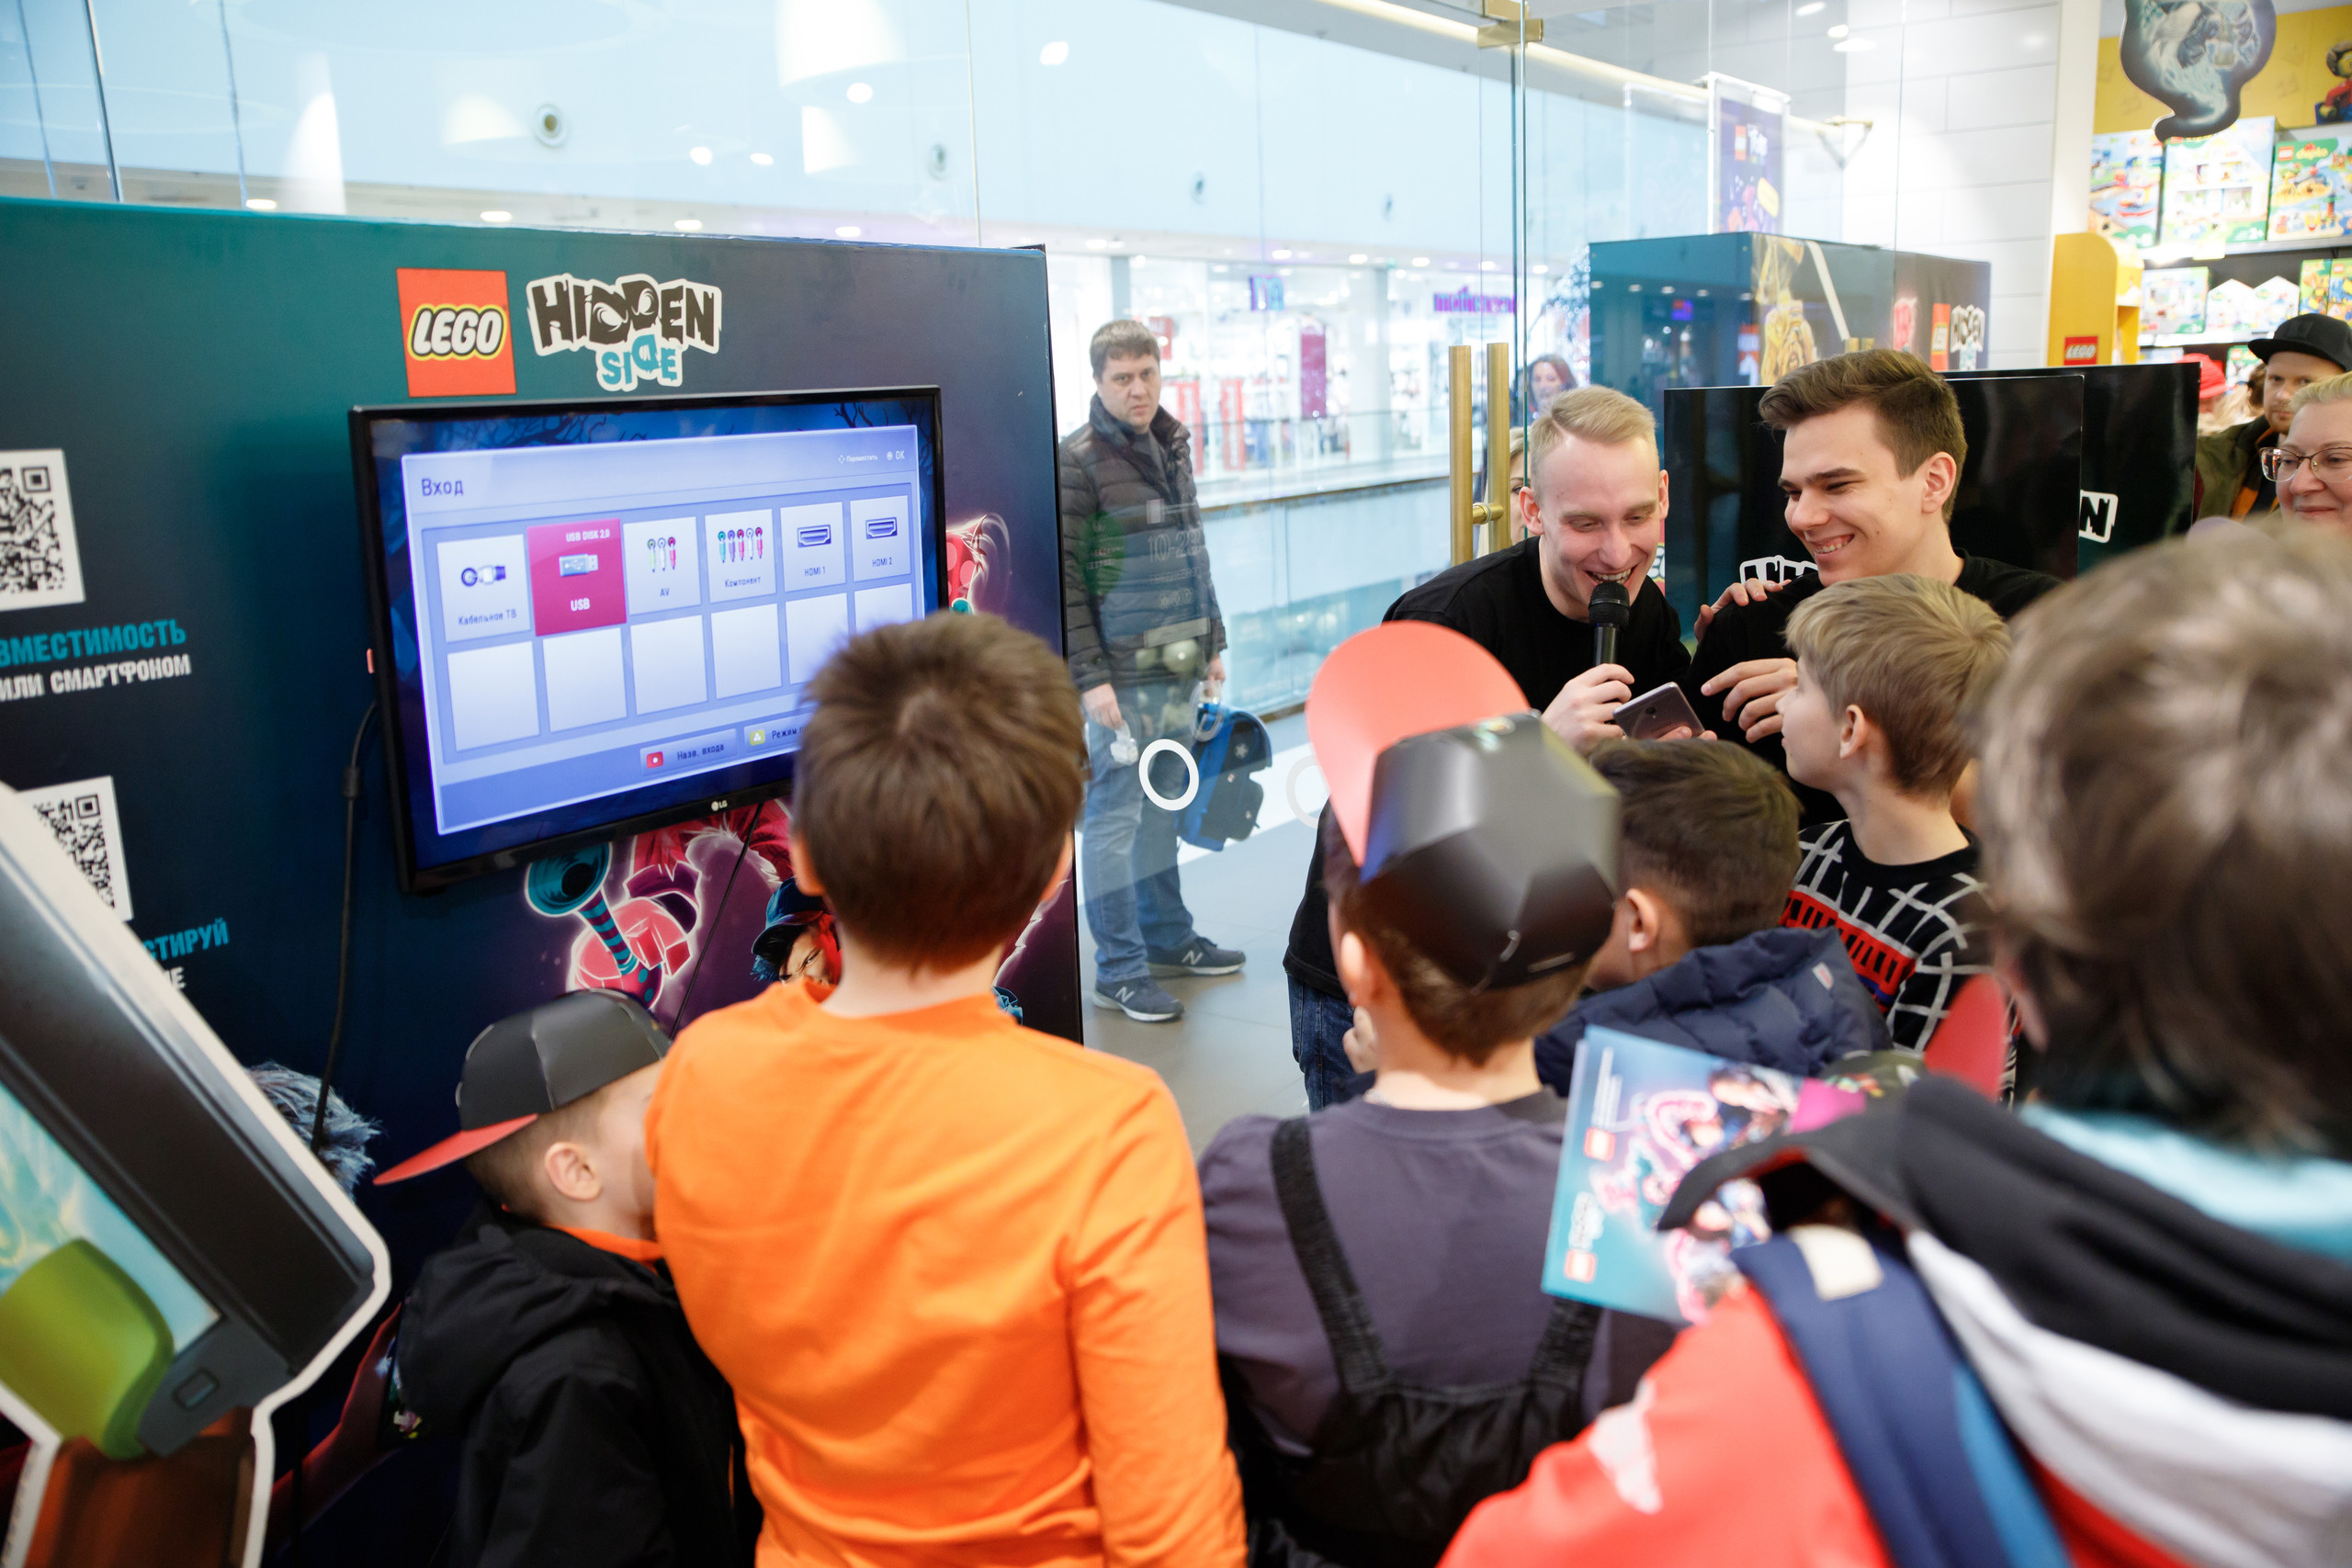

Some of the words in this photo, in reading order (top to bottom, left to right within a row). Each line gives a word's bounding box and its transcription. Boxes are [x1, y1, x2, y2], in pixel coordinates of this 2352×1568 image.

[411, 307, 504, 357] LEGO
[529, 276, 717, 352] HIDDEN
[2064, 344, 2097, 359] LEGO
[600, 333, 680, 386] SIDE
[421, 478, 464, 497] Вход
[566, 532, 582, 542] USB
[582, 530, 599, 541] DISK
[873, 558, 888, 567] HDMI
[805, 567, 822, 576] HDMI
[725, 576, 762, 588] Компонент
[660, 588, 670, 596] AV
[570, 598, 591, 612] USB
[458, 611, 503, 626] Кабельное
[506, 609, 517, 620] ТВ
[0, 618, 187, 668] ВМЕСТИМОСТЬ
[0, 672, 45, 702] ИЛИ
[50, 653, 192, 694] СМАРТФОНОМ
[772, 728, 797, 739] Режим
[676, 748, 699, 761] Назв.
[702, 743, 724, 756] входа
